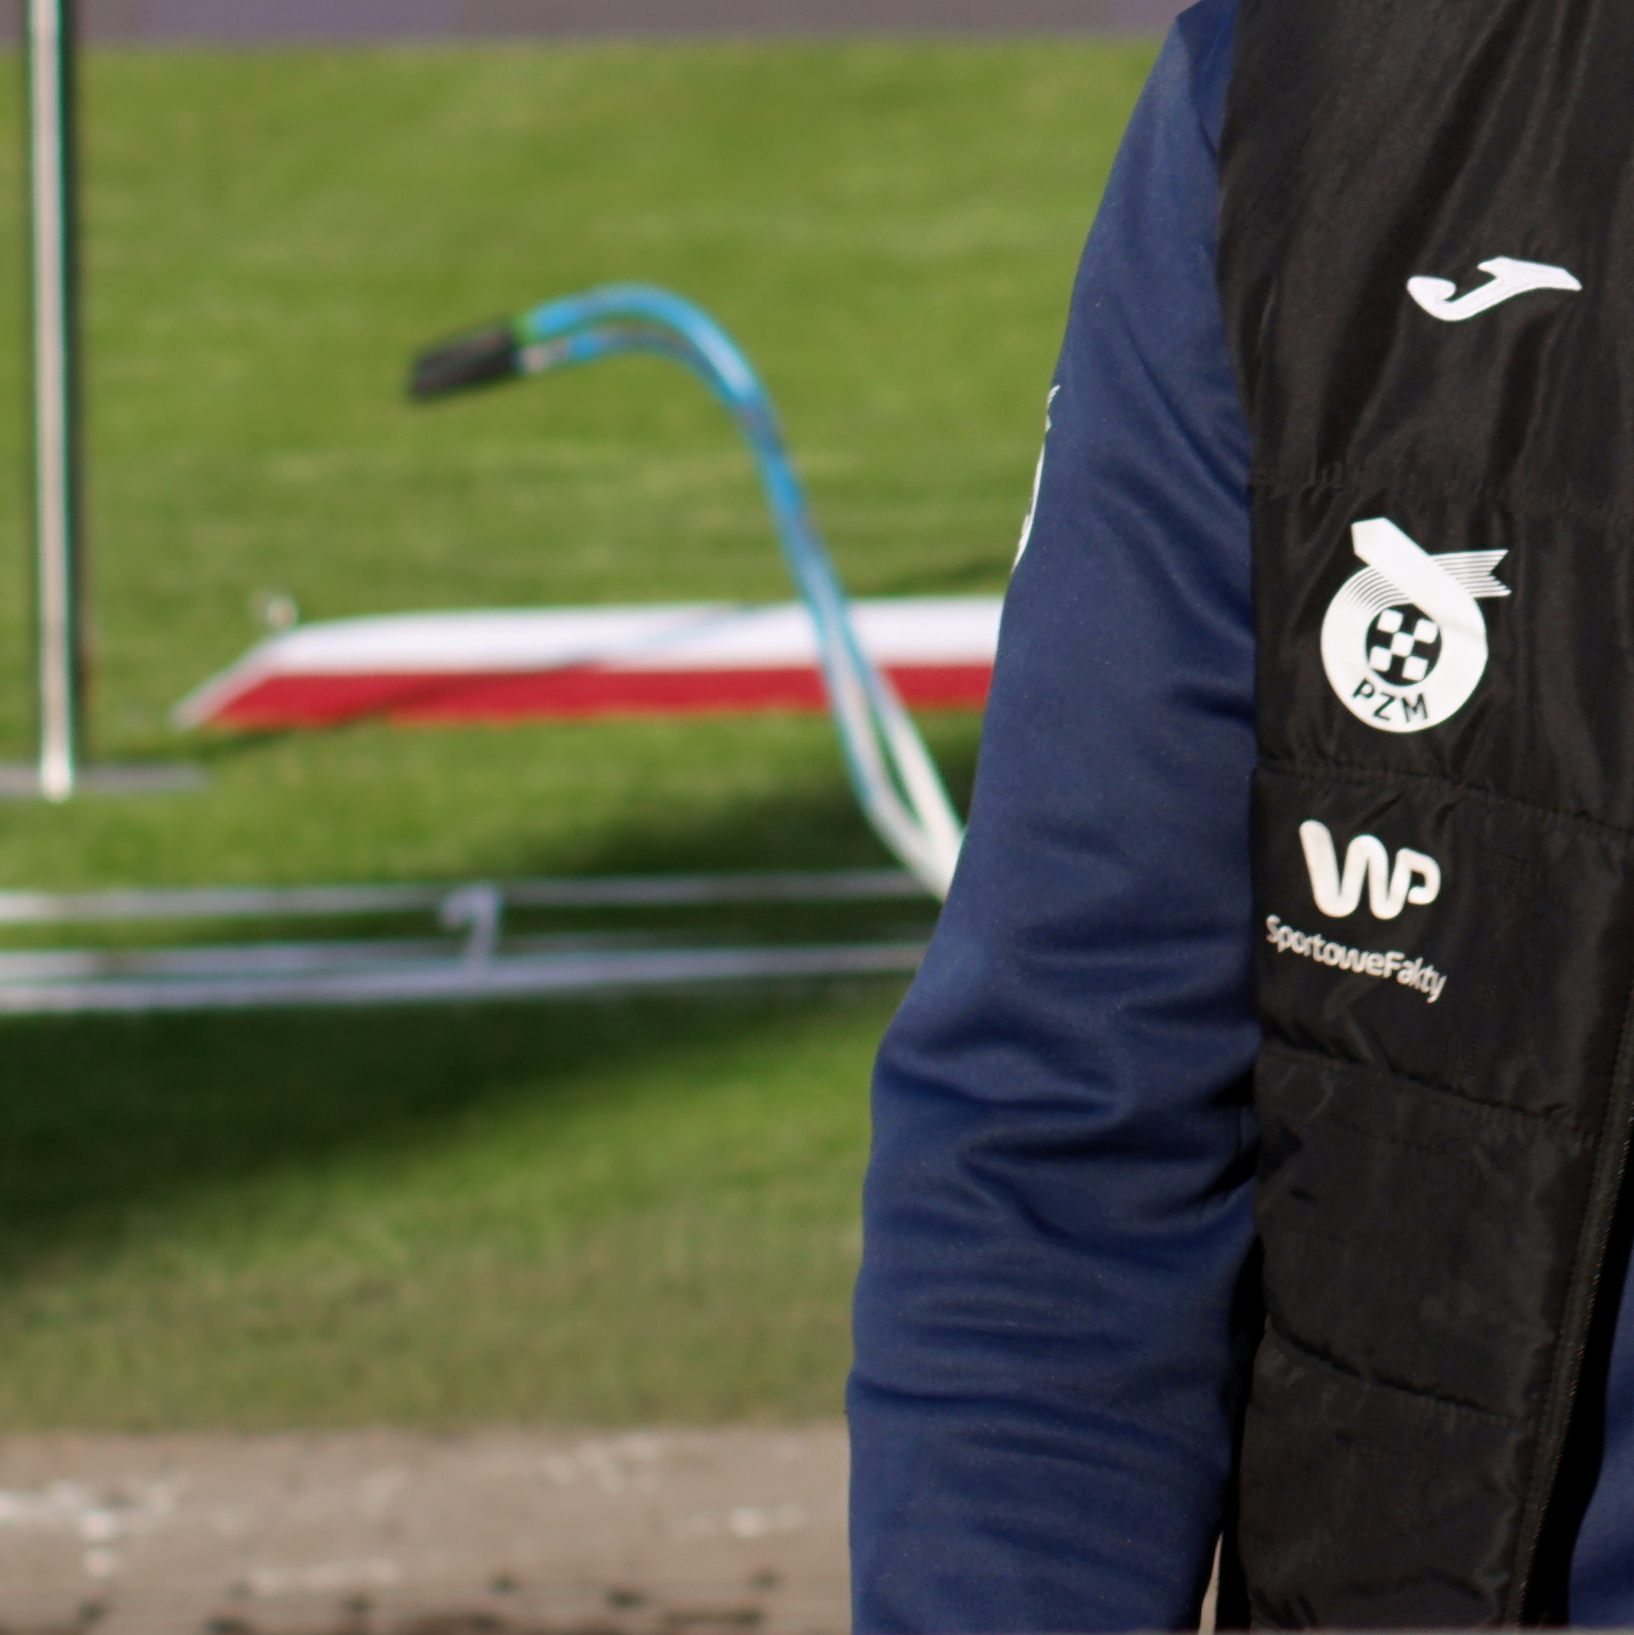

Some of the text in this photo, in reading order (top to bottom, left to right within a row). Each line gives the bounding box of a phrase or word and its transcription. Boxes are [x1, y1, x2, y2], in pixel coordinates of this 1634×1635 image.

[1352, 677, 1430, 724] PZM
[1299, 819, 1441, 920] WP
[1265, 914, 1448, 1005] SportoweFakty
